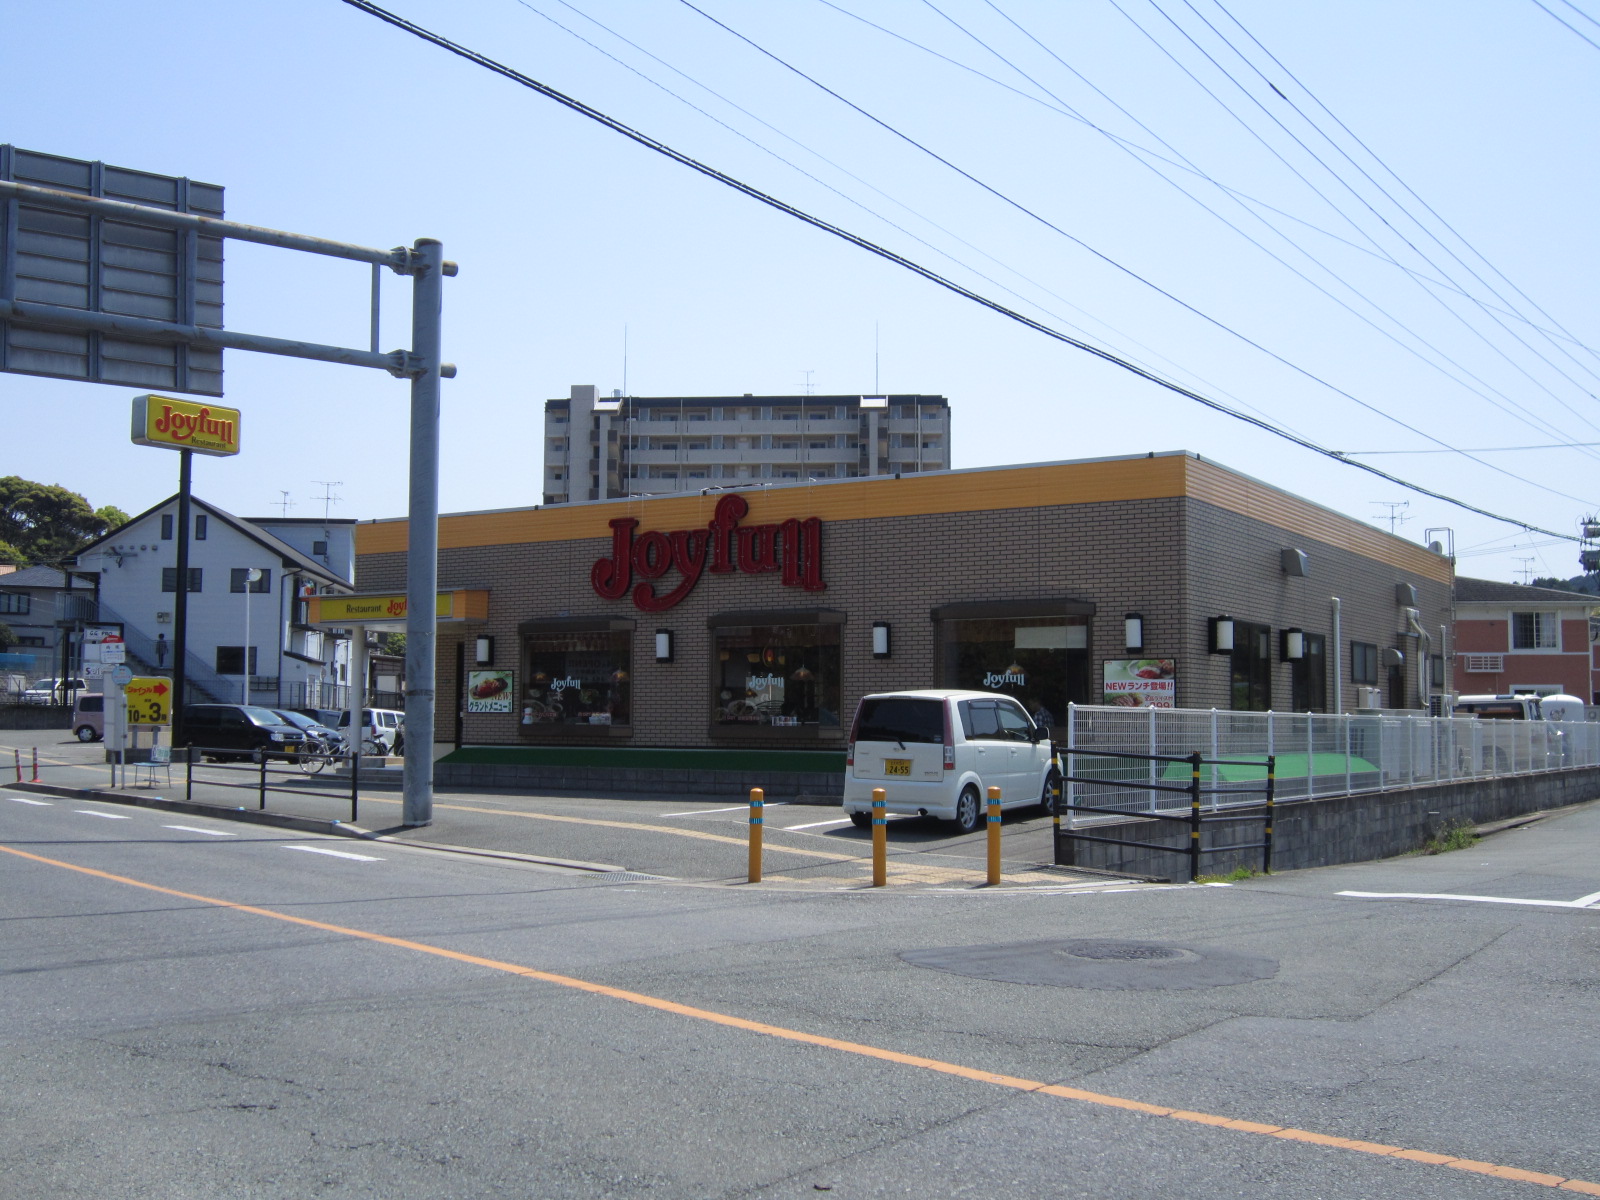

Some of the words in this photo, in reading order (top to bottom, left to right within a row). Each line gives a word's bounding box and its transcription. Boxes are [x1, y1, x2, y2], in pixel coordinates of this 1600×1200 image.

[155, 405, 233, 444] Joyfull
[191, 435, 226, 448] Restaurant
[591, 494, 827, 612] Joyfull
[346, 604, 381, 613] Restaurant
[551, 676, 581, 692] Joyfull
[749, 673, 784, 690] Joyfull
[984, 670, 1025, 688] Joyfull
[469, 701, 508, 712] グランドメニュー
[889, 766, 909, 774] 24-55
